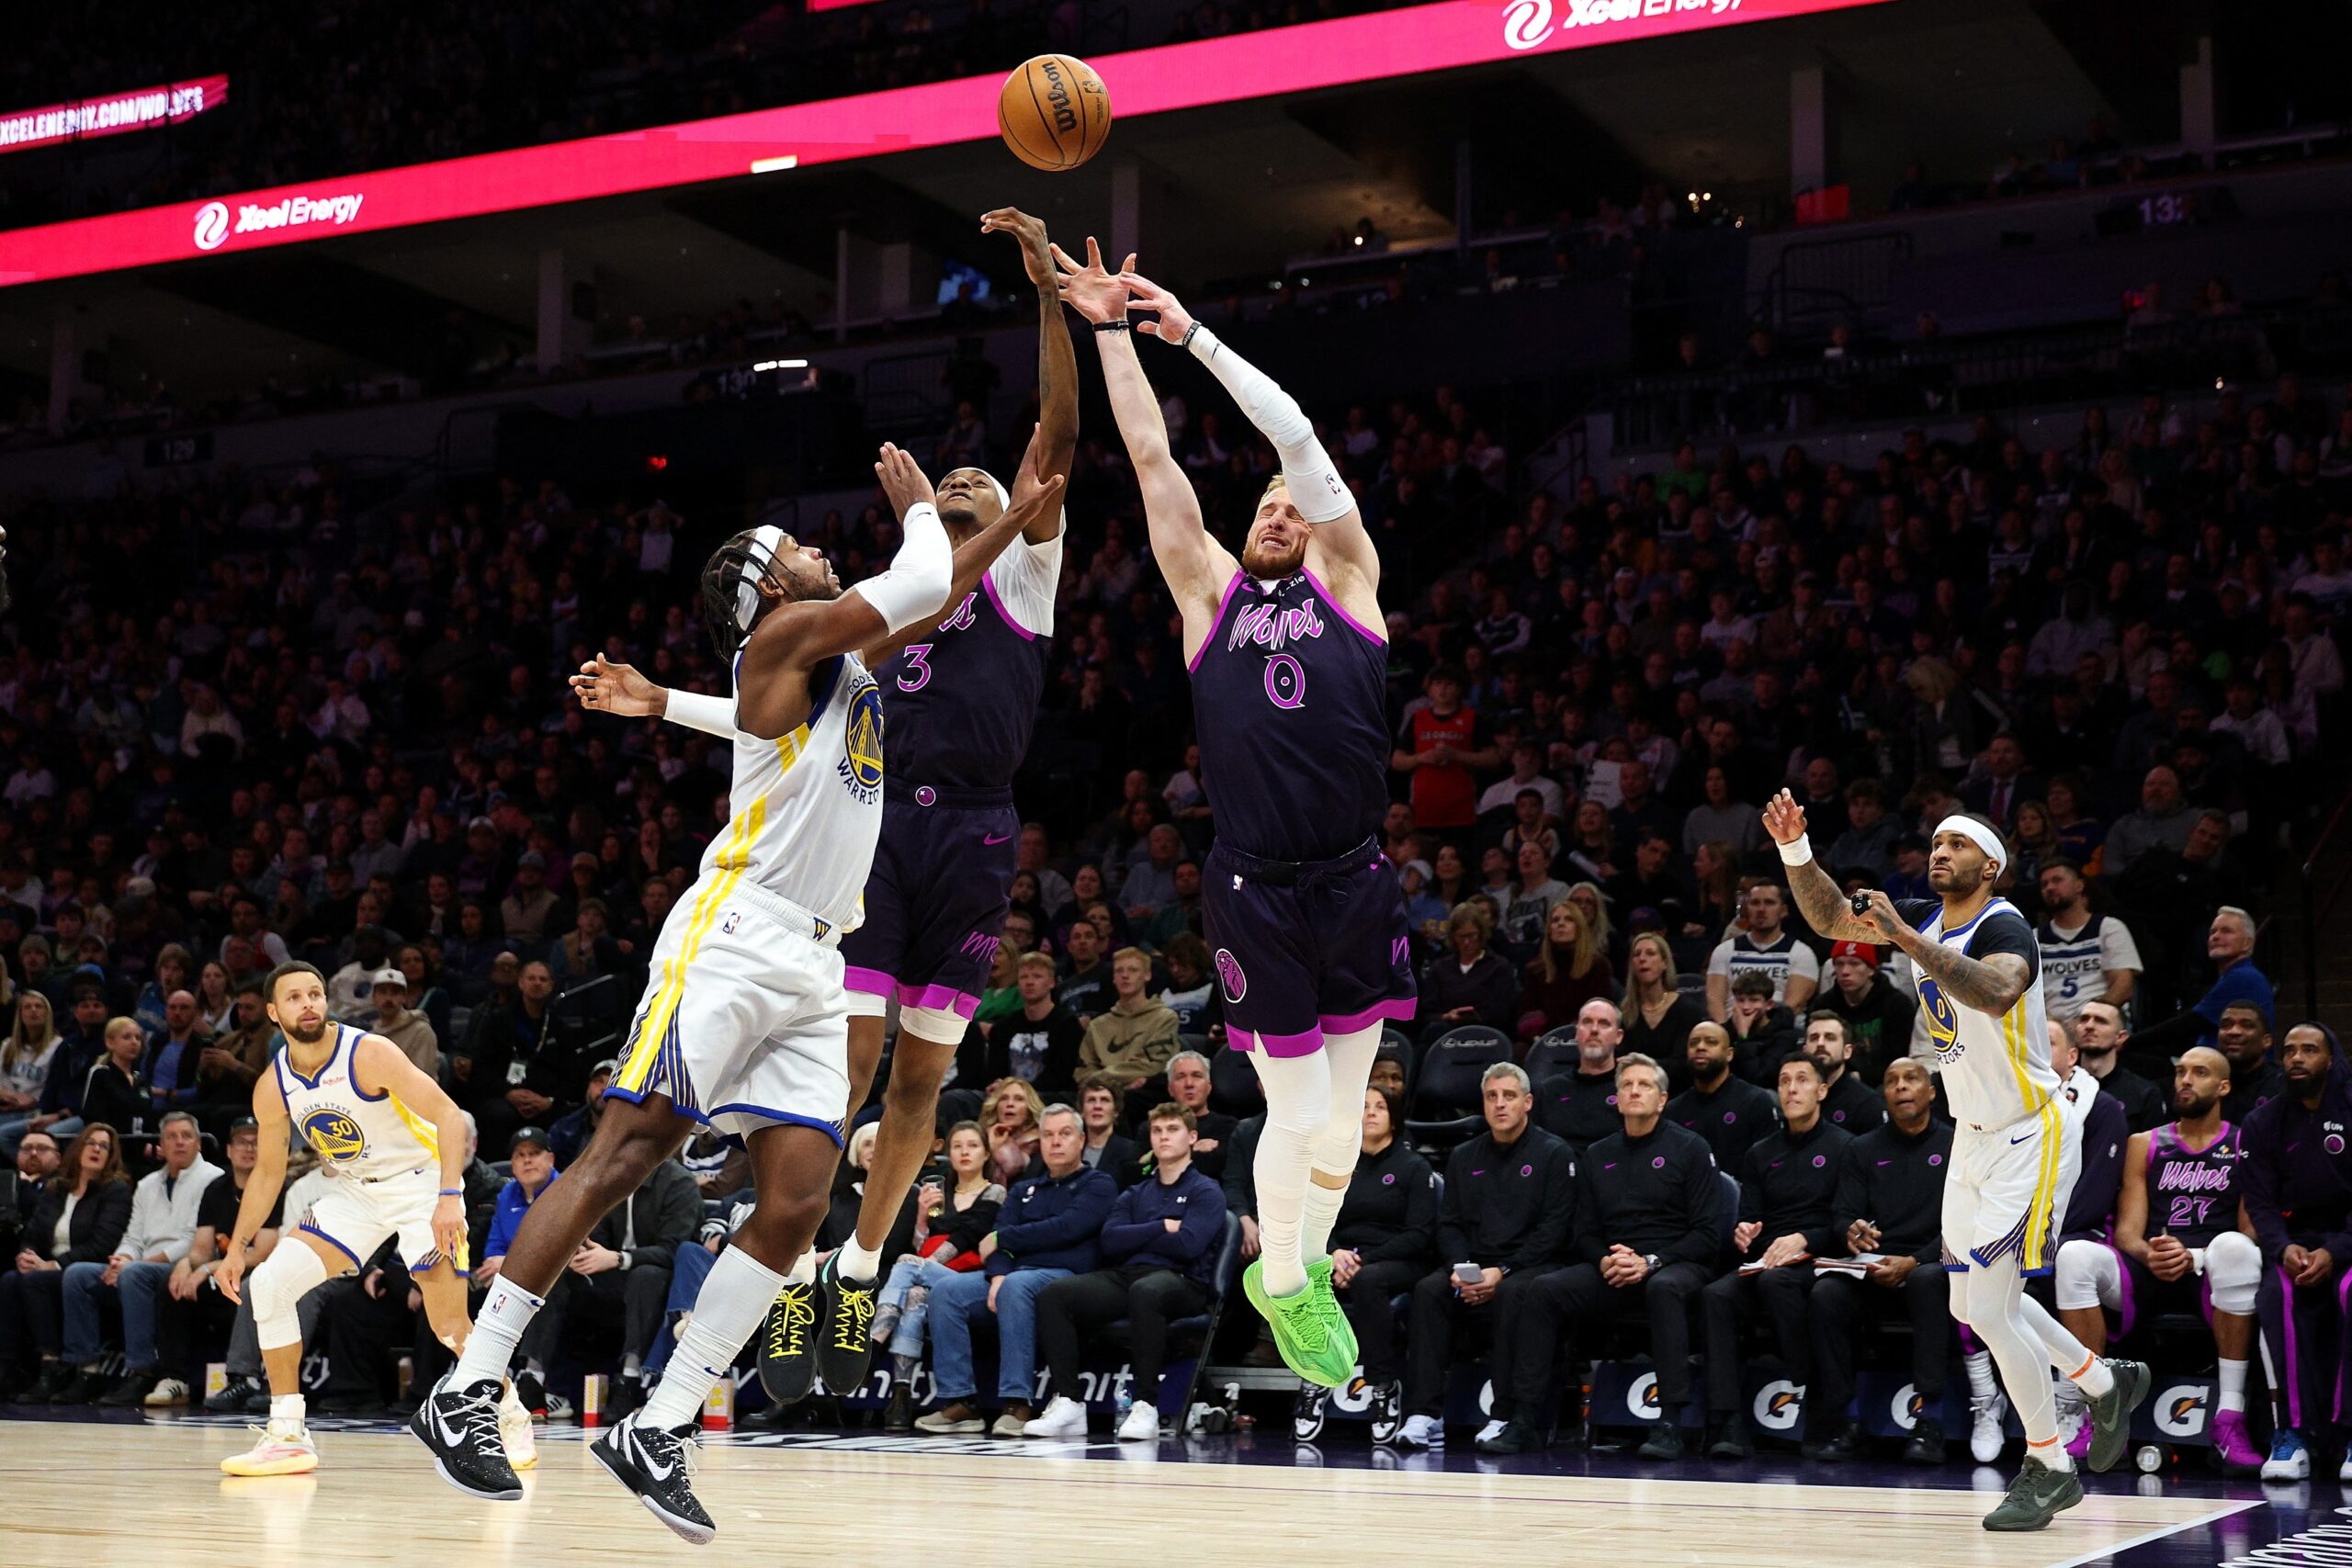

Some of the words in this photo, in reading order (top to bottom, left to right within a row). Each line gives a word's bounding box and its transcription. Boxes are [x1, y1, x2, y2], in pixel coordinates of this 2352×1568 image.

[1228, 598, 1325, 652] Wolves
[897, 644, 934, 692] 3
[1264, 653, 1306, 709] 0
[2041, 958, 2101, 975] WOLVES
[2060, 976, 2079, 998] 5
[1937, 998, 1946, 1020] 0
[324, 1102, 353, 1115] STATE
[327, 1119, 353, 1138] 30
[2158, 1161, 2232, 1192] Wolves
[2167, 1195, 2218, 1226] 27
[2154, 1385, 2210, 1437] G
